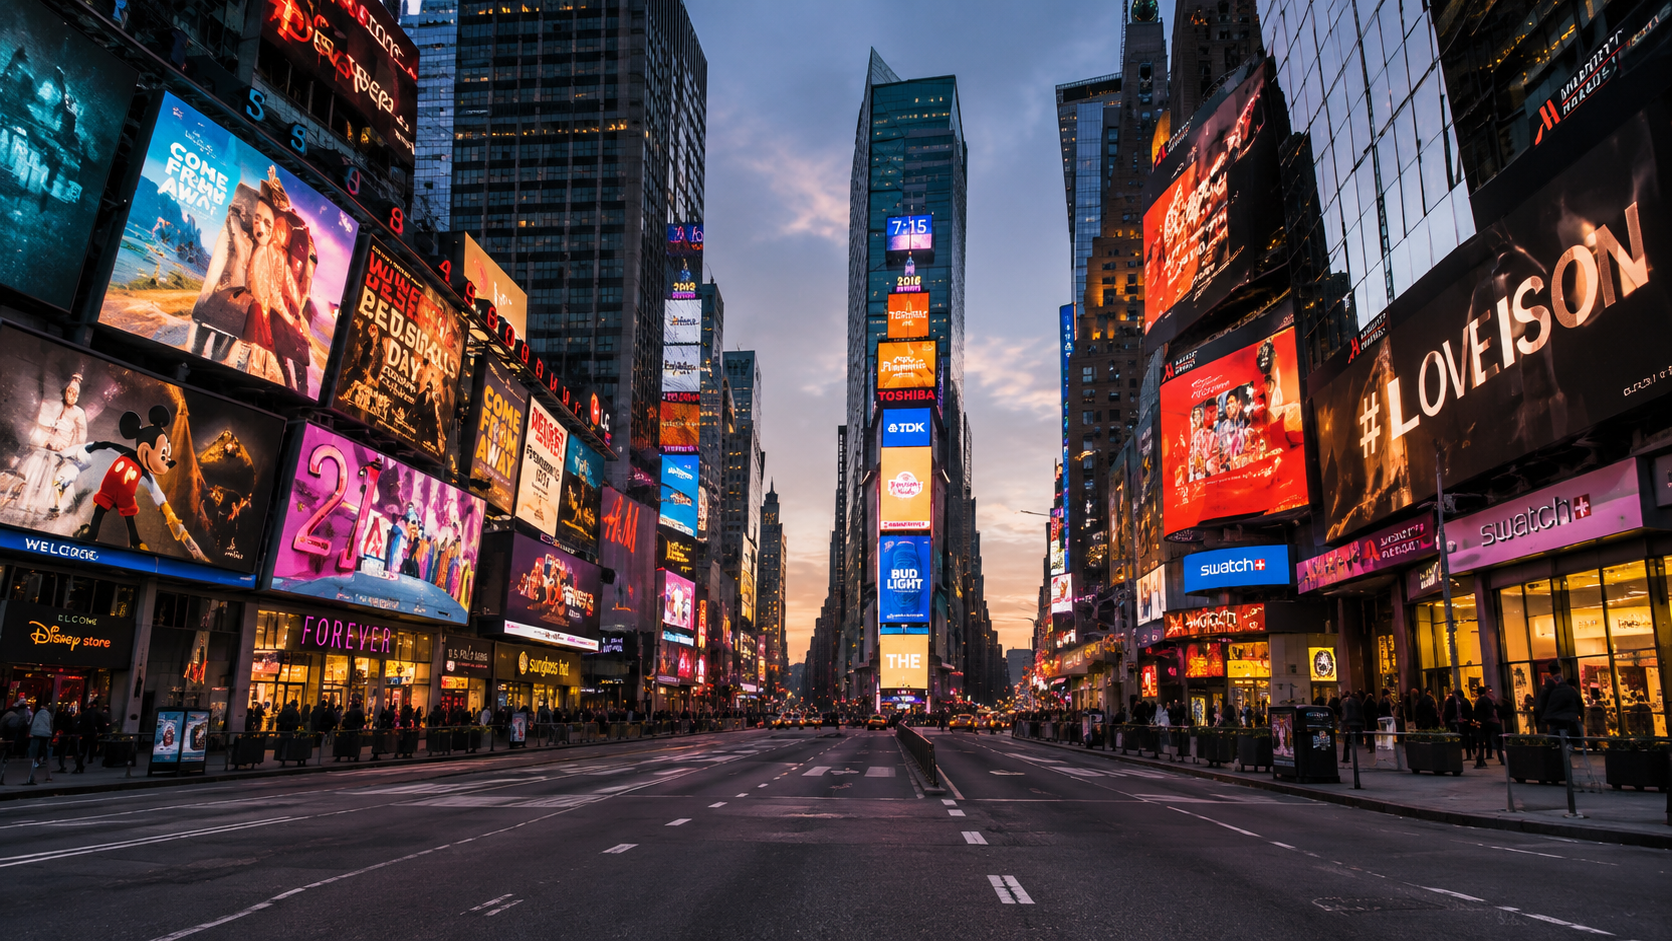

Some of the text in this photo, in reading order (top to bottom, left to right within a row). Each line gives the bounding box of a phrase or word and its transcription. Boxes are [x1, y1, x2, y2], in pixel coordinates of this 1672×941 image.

[387, 338, 421, 382] DAY
[877, 390, 935, 402] TOSHIBA
[484, 385, 522, 434] COME
[898, 423, 925, 433] TDK
[475, 433, 515, 480] AWAY
[1480, 497, 1572, 546] swatch
[891, 568, 918, 579] BUD
[1200, 558, 1253, 576] swatch
[887, 579, 923, 590] LIGHT
[83, 636, 111, 648] store
[301, 615, 391, 653] FOREVER
[886, 654, 921, 669] THE
